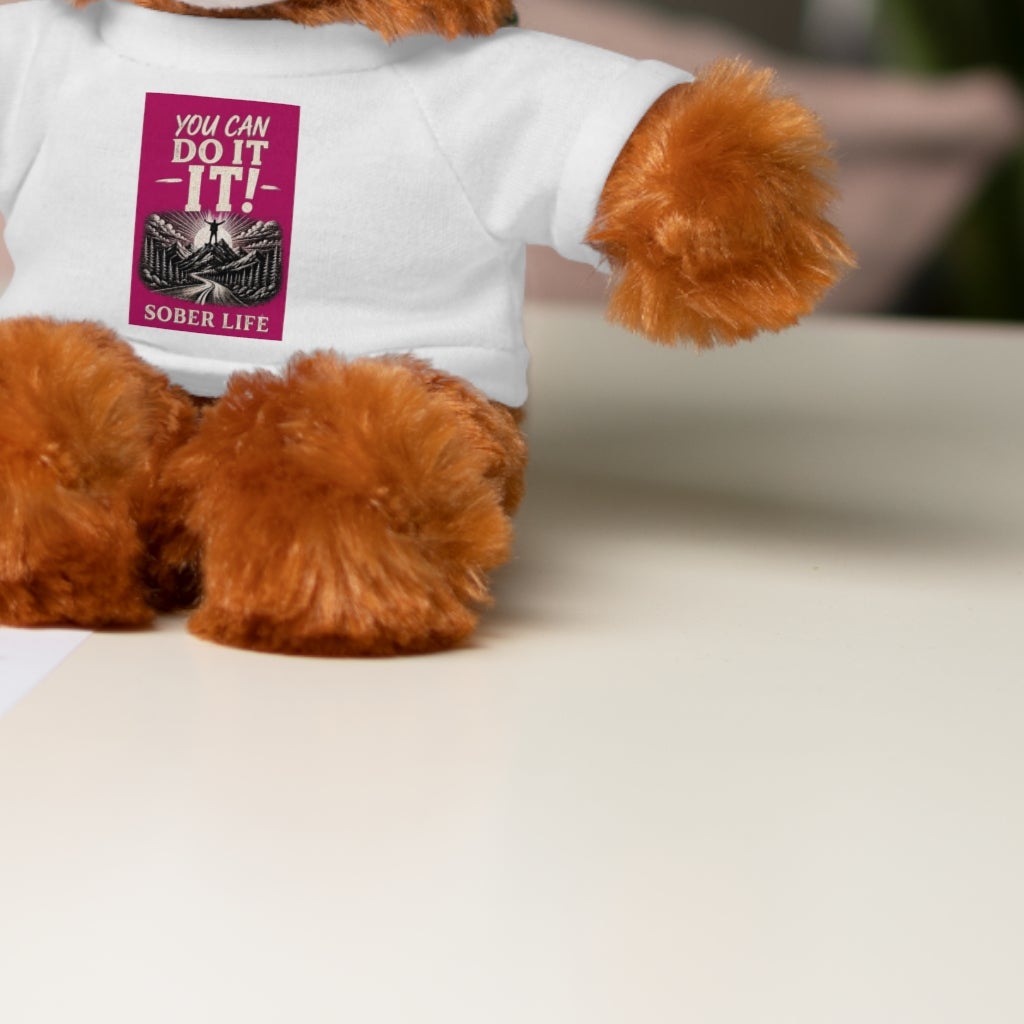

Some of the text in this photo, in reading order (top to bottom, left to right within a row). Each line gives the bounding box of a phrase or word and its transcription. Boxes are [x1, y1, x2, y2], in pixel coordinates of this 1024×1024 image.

[175, 114, 271, 138] YOU CAN
[171, 138, 269, 165] DO IT
[144, 304, 269, 333] SOBER LIFE
